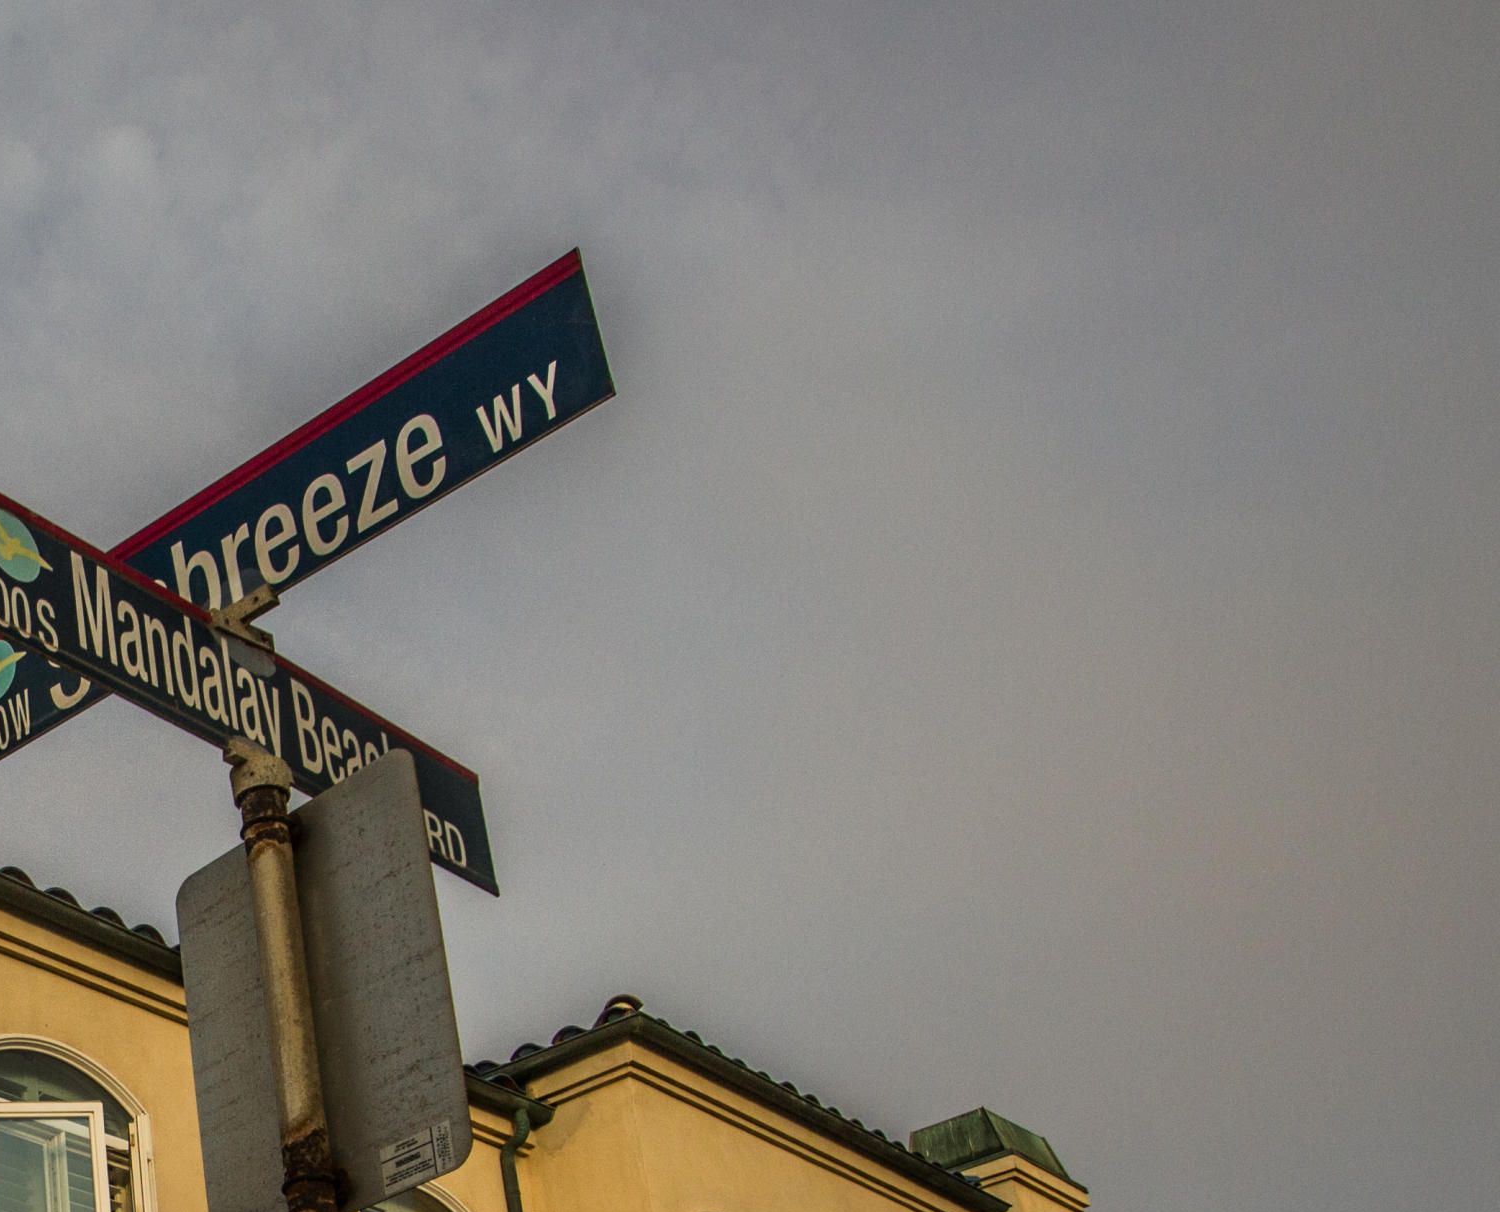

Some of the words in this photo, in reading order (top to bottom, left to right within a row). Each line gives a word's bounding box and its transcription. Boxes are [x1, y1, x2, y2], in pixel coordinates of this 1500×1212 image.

[476, 361, 557, 453] WY
[70, 550, 282, 758] Mandalay
[291, 677, 389, 785] Bea
[423, 808, 467, 869] RD
